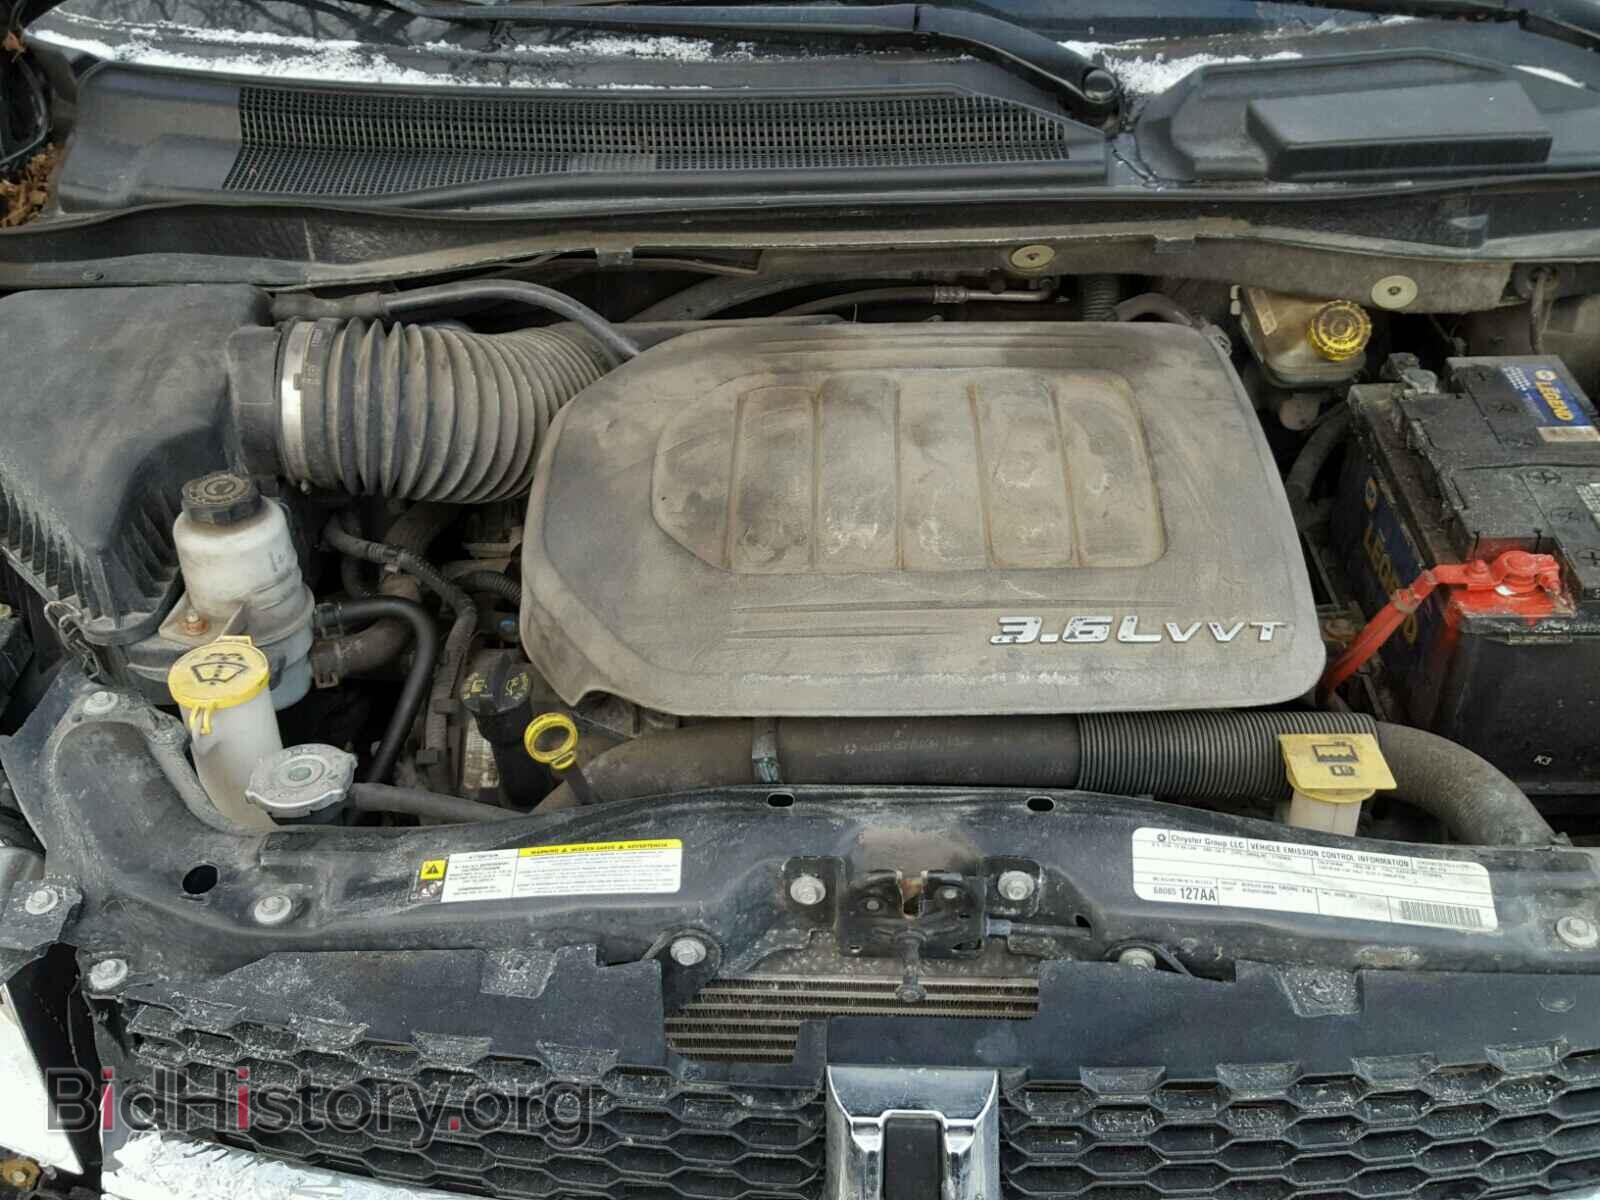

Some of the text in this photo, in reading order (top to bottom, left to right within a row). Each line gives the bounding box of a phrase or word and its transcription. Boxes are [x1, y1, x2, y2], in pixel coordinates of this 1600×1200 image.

[1171, 833, 1202, 845] Chrysler
[1204, 838, 1228, 848] Group
[1229, 840, 1245, 849] LLC
[1250, 841, 1281, 853] VEHICLE
[1283, 846, 1319, 857] EMISSION
[1321, 851, 1354, 862] CONTROL
[1357, 855, 1409, 868] INFORMATION
[1180, 887, 1216, 901] 127AA
